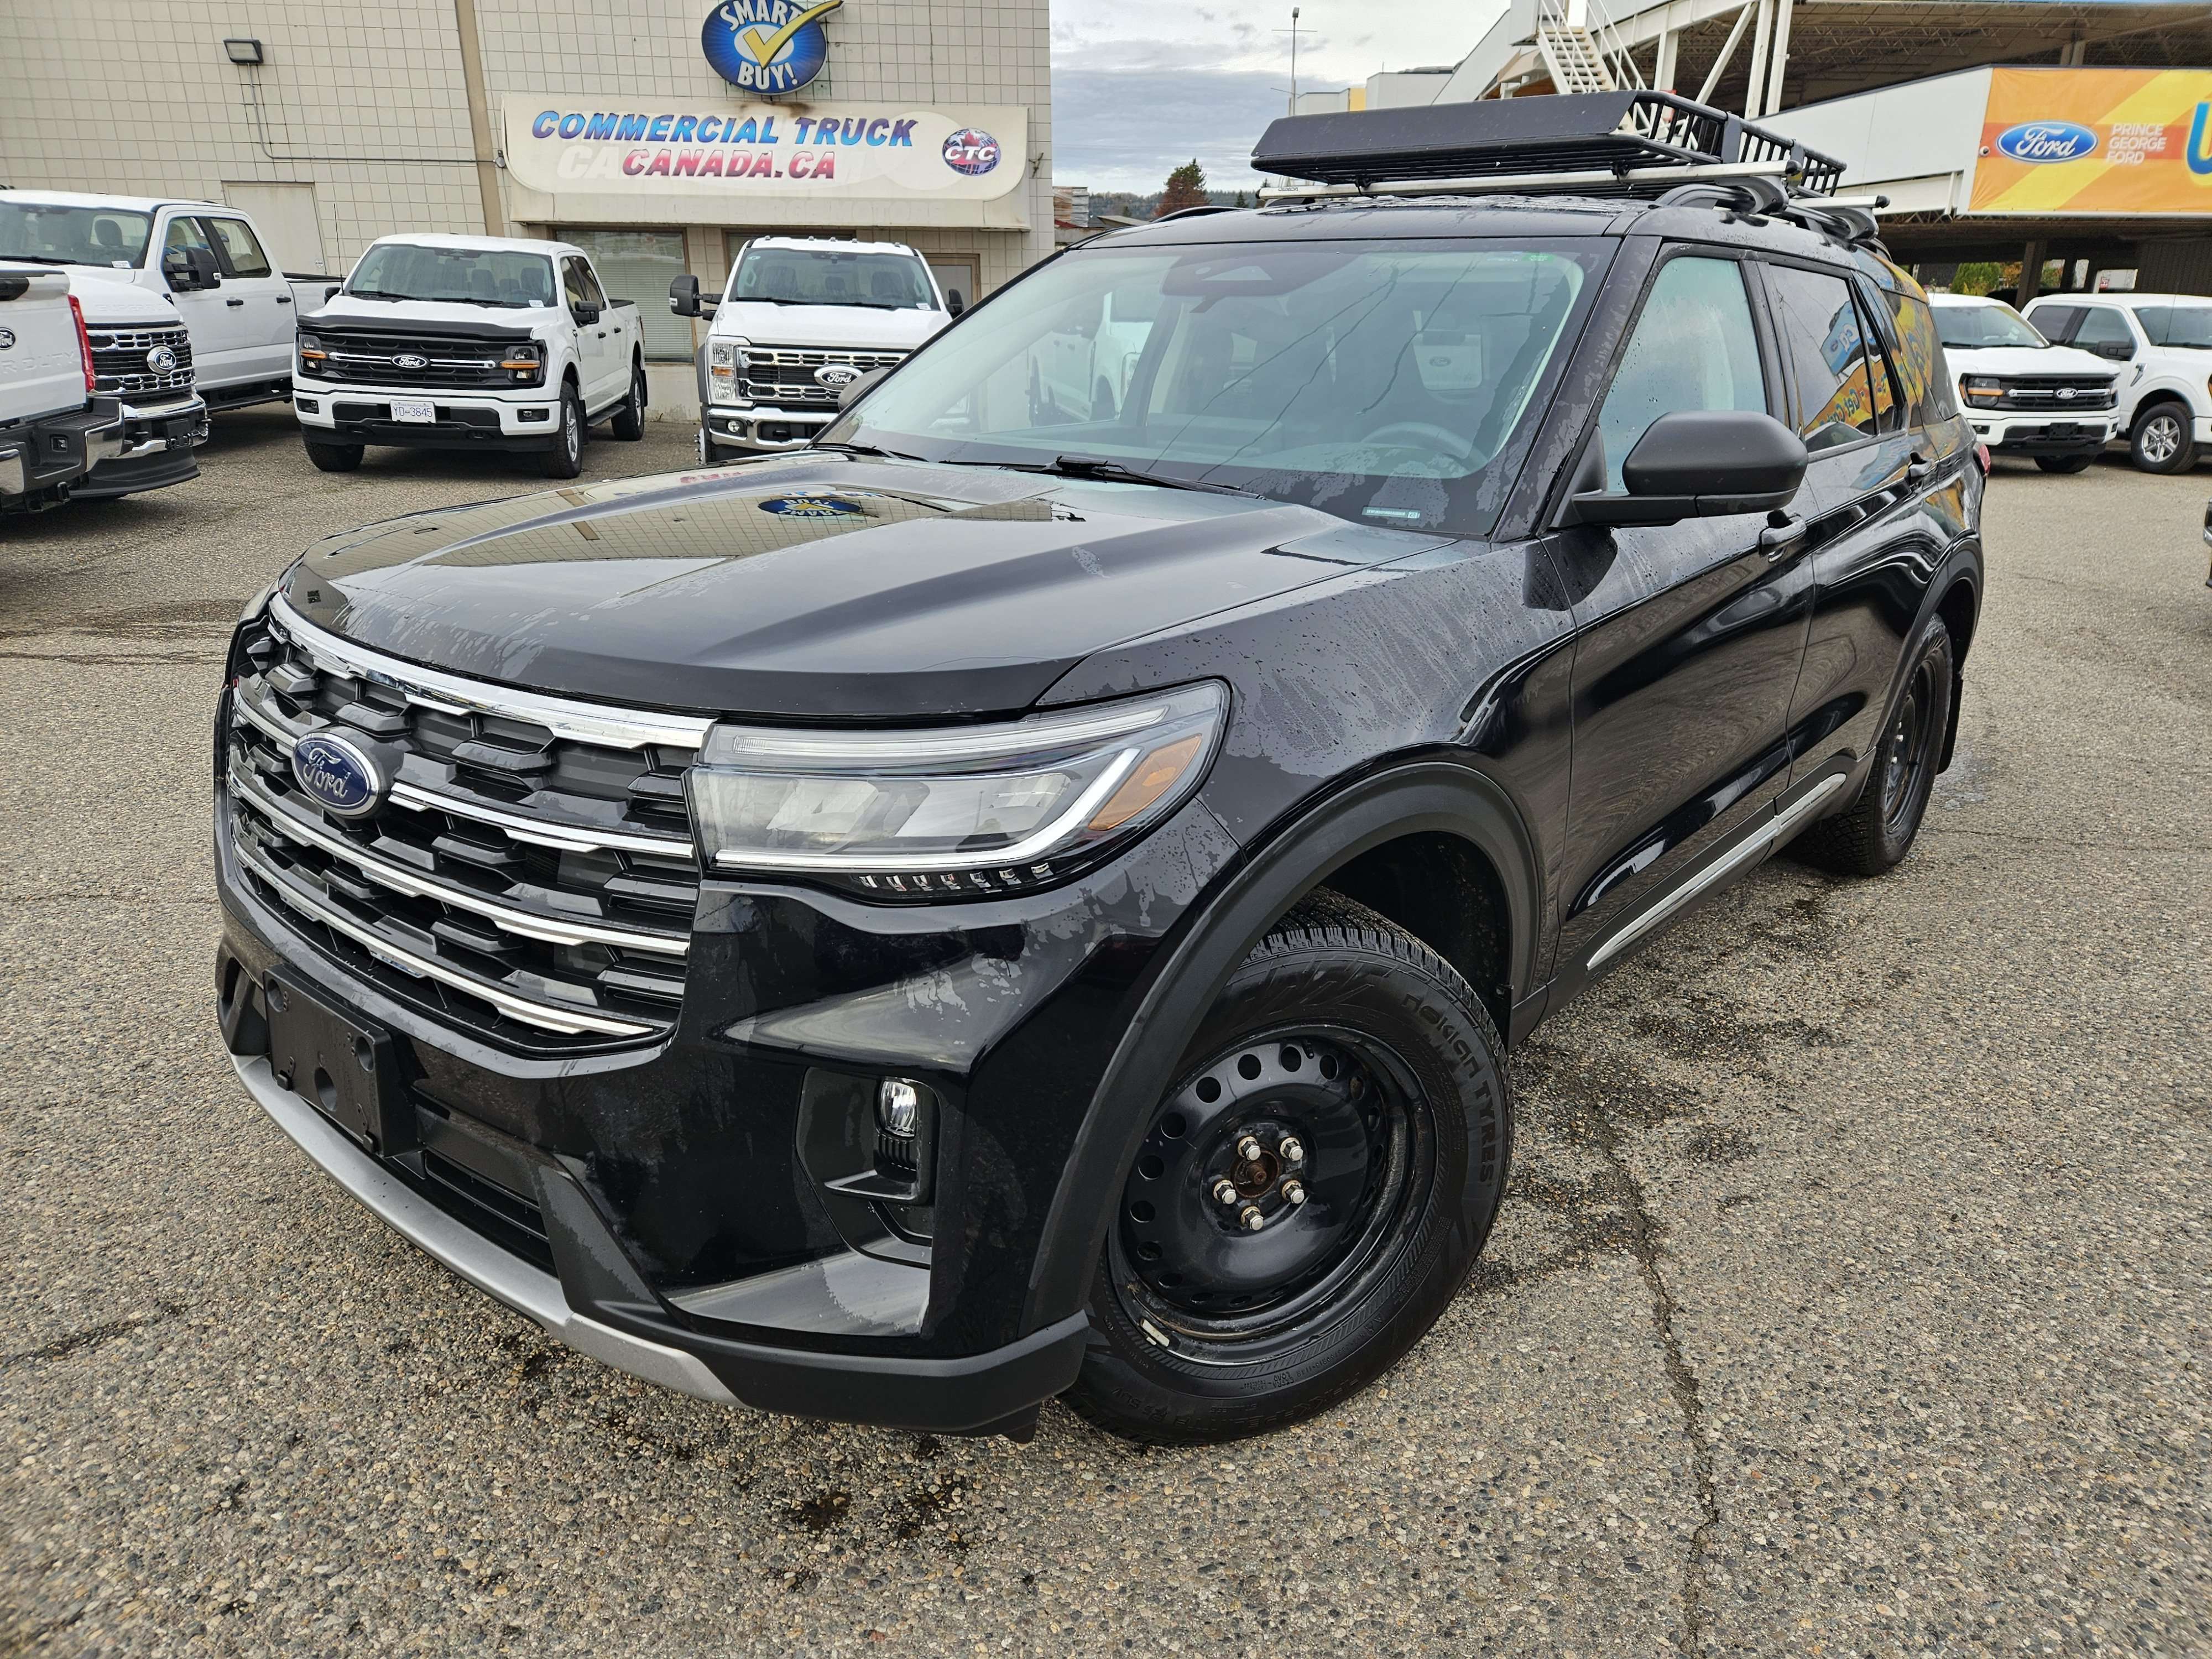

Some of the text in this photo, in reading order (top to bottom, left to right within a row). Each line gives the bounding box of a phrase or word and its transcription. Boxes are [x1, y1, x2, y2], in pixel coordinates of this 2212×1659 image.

[720, 0, 804, 31] SMART
[737, 61, 798, 90] BUY!
[532, 111, 918, 147] COMMERCIAL TRUCK
[2016, 126, 2080, 158] Ford
[2109, 137, 2166, 150] GEORGE
[2110, 123, 2164, 136] PRINCE
[622, 149, 835, 180] CANADA.CA
[945, 145, 996, 161] CTC
[2106, 151, 2145, 164] FORD
[398, 356, 421, 367] Ford
[826, 371, 853, 384] Ford
[302, 747, 351, 799] Ford
[1474, 1079, 1497, 1182] TYRES
